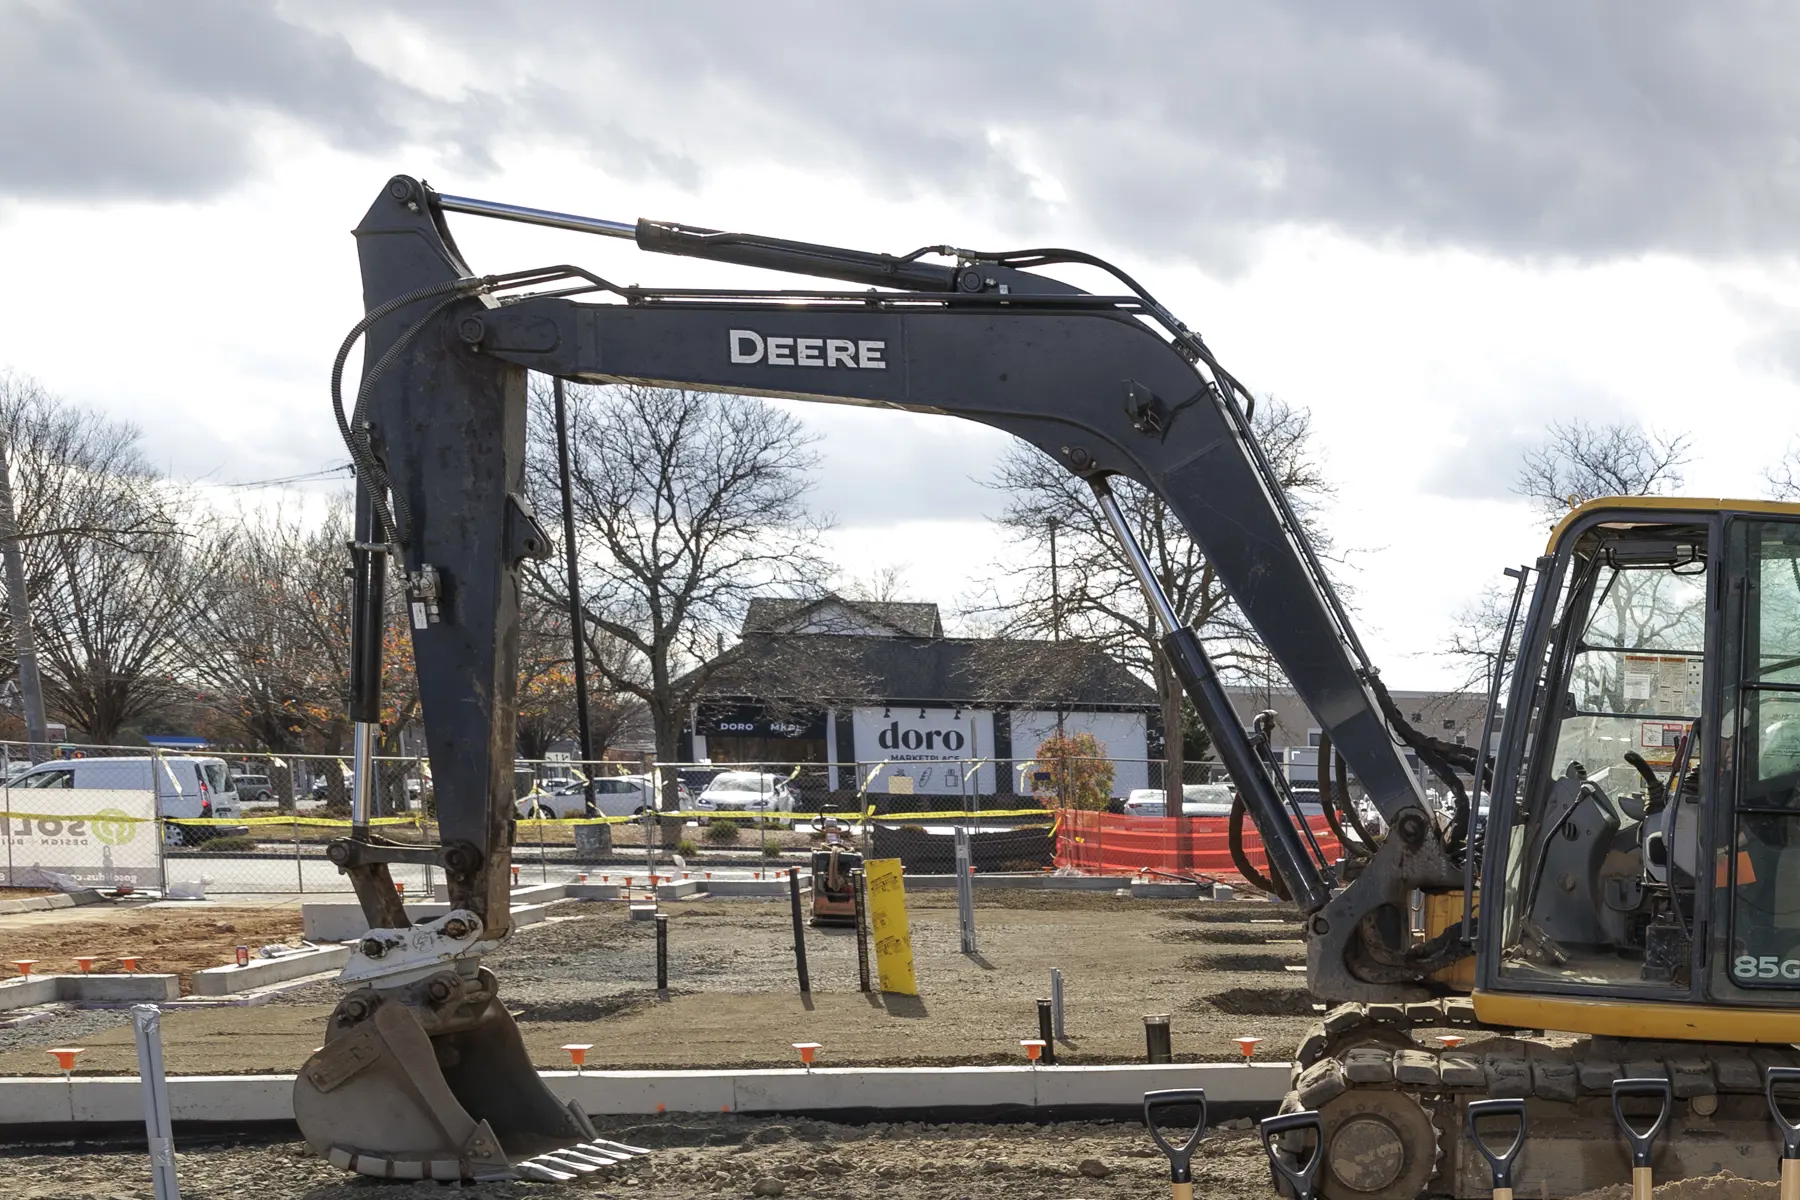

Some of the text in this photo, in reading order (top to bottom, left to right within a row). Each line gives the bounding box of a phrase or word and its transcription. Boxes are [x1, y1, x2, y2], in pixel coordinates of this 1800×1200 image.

[729, 329, 887, 369] DEERE
[720, 723, 754, 731] DORO
[878, 720, 965, 751] doro
[1733, 955, 1800, 979] 85G
